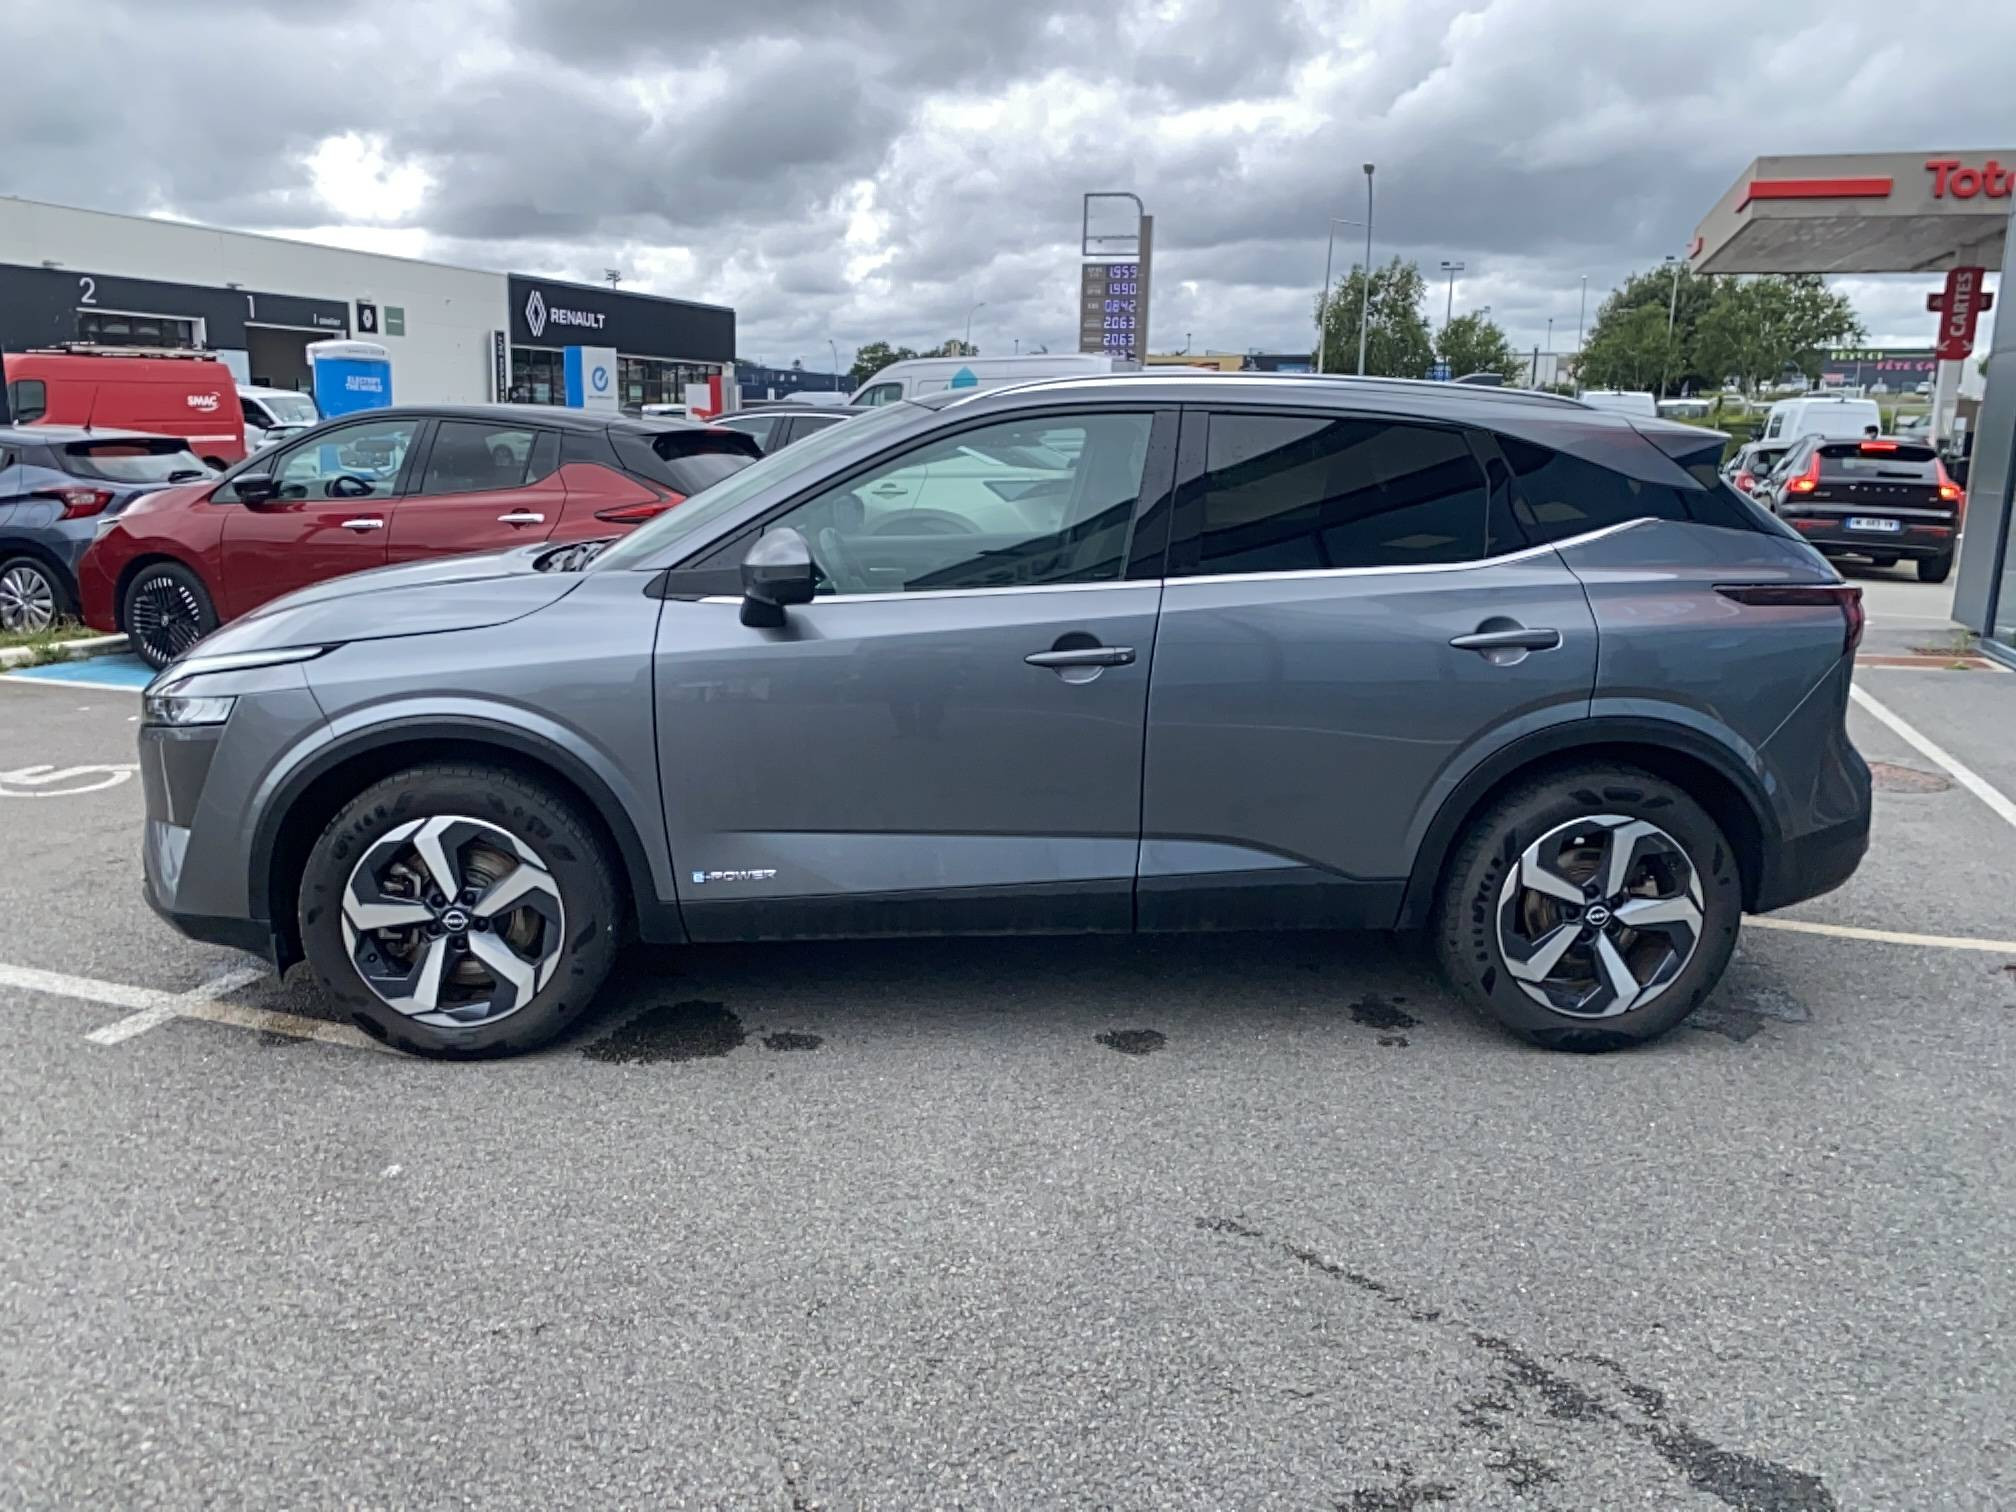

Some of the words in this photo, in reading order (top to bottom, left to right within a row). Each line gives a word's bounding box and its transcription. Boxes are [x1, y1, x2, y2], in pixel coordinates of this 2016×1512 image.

[79, 277, 97, 303] 2
[247, 295, 255, 319] 1
[1950, 272, 1973, 337] CARTES
[550, 307, 605, 329] RENAULT
